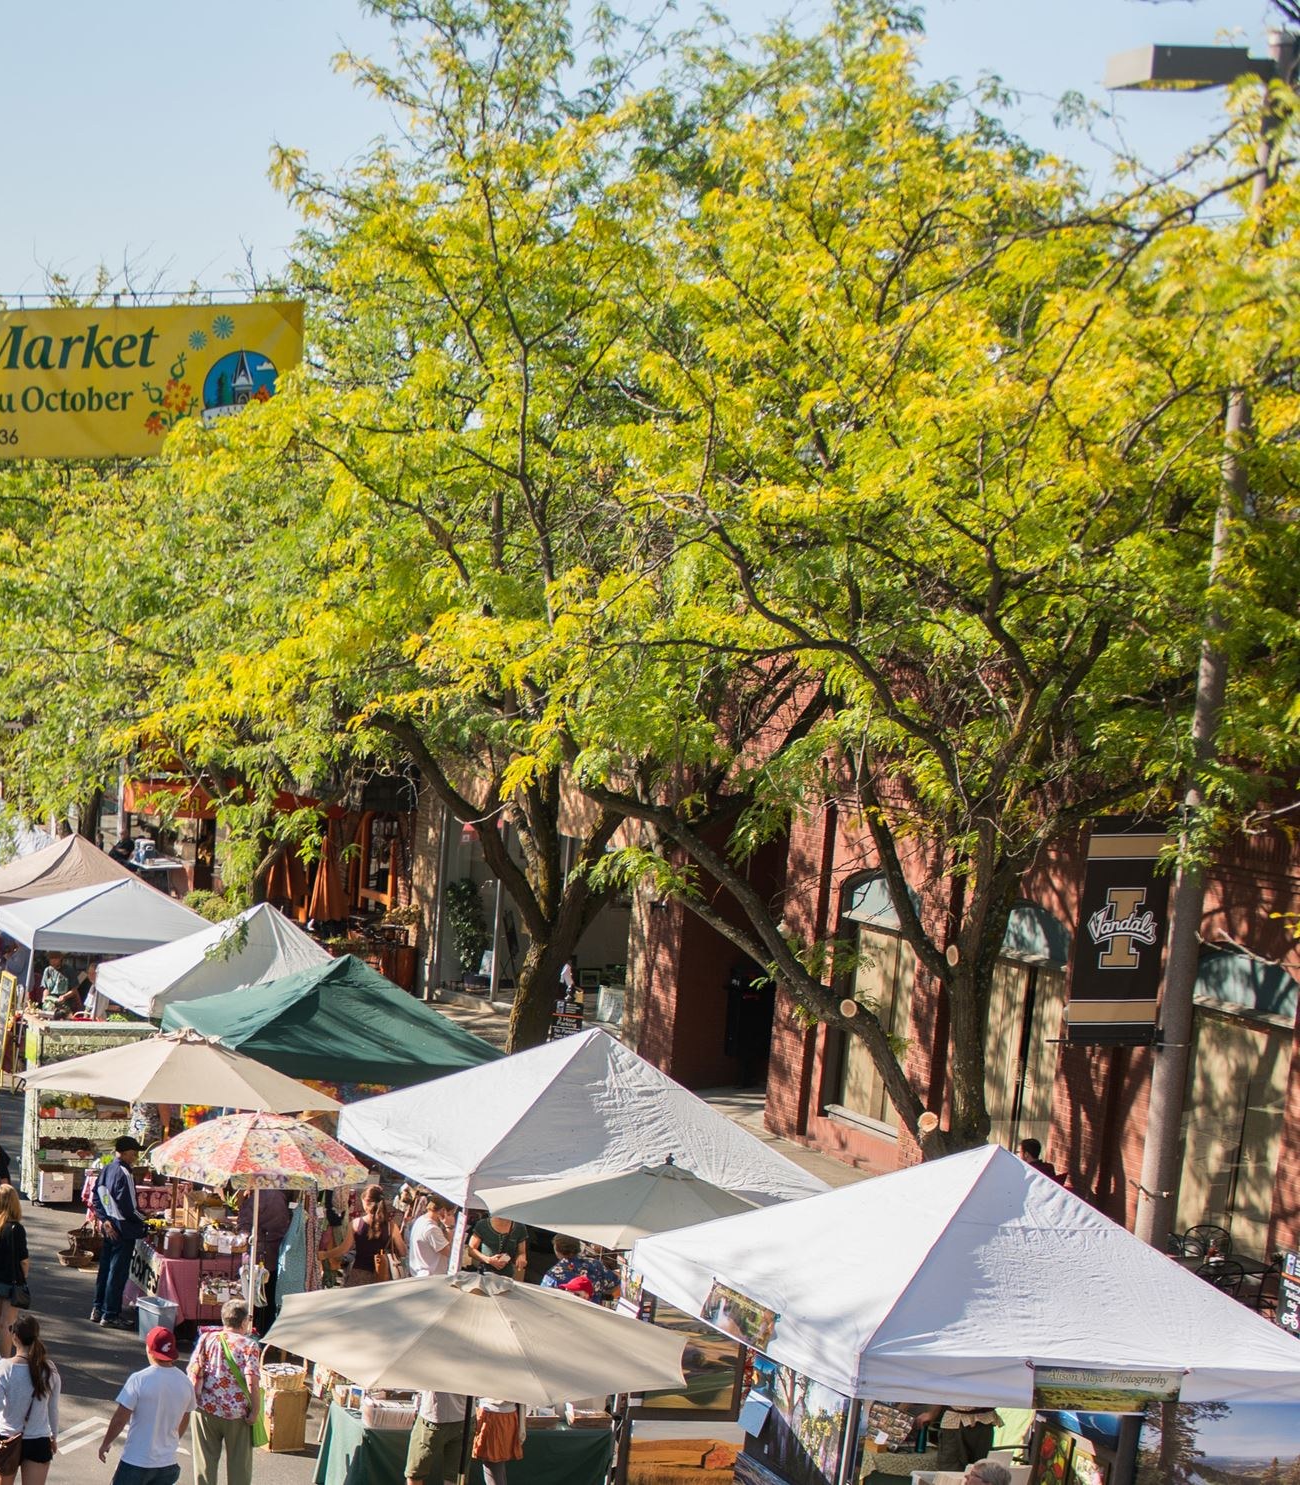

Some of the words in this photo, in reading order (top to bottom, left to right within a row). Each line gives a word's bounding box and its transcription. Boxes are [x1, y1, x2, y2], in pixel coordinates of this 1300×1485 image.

[21, 386, 134, 413] October
[1088, 909, 1157, 942] Vandals
[1048, 1368, 1078, 1381] Alison
[1110, 1372, 1169, 1388] Photography
